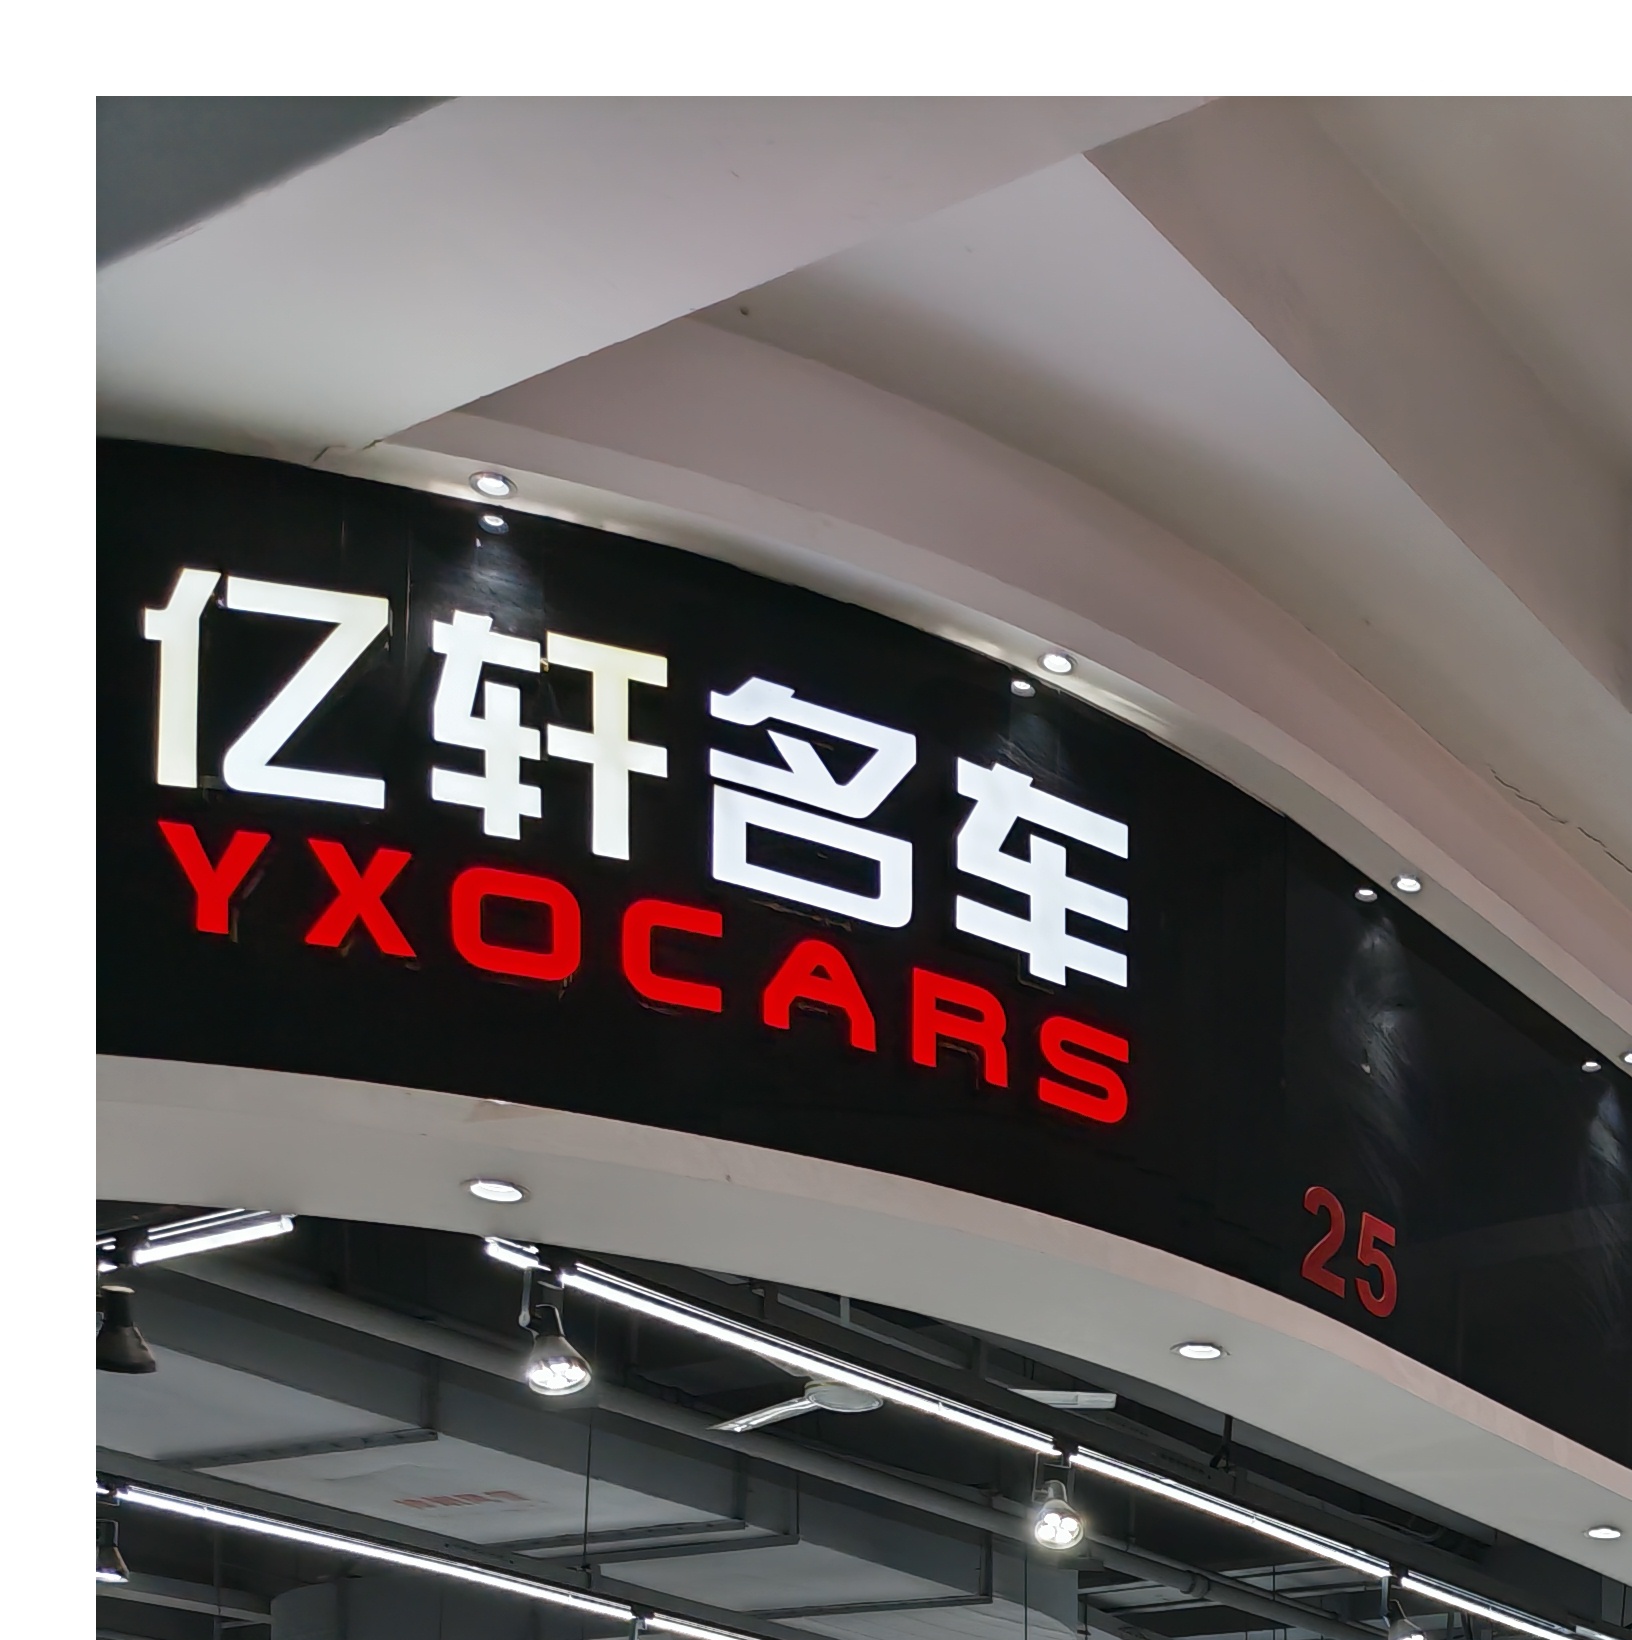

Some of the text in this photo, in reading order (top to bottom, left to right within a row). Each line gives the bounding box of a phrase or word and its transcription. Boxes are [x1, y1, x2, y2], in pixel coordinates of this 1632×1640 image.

[144, 568, 1129, 988] 亿轩名车
[158, 820, 1129, 1124] YXOCARS
[1301, 1185, 1398, 1317] 25
